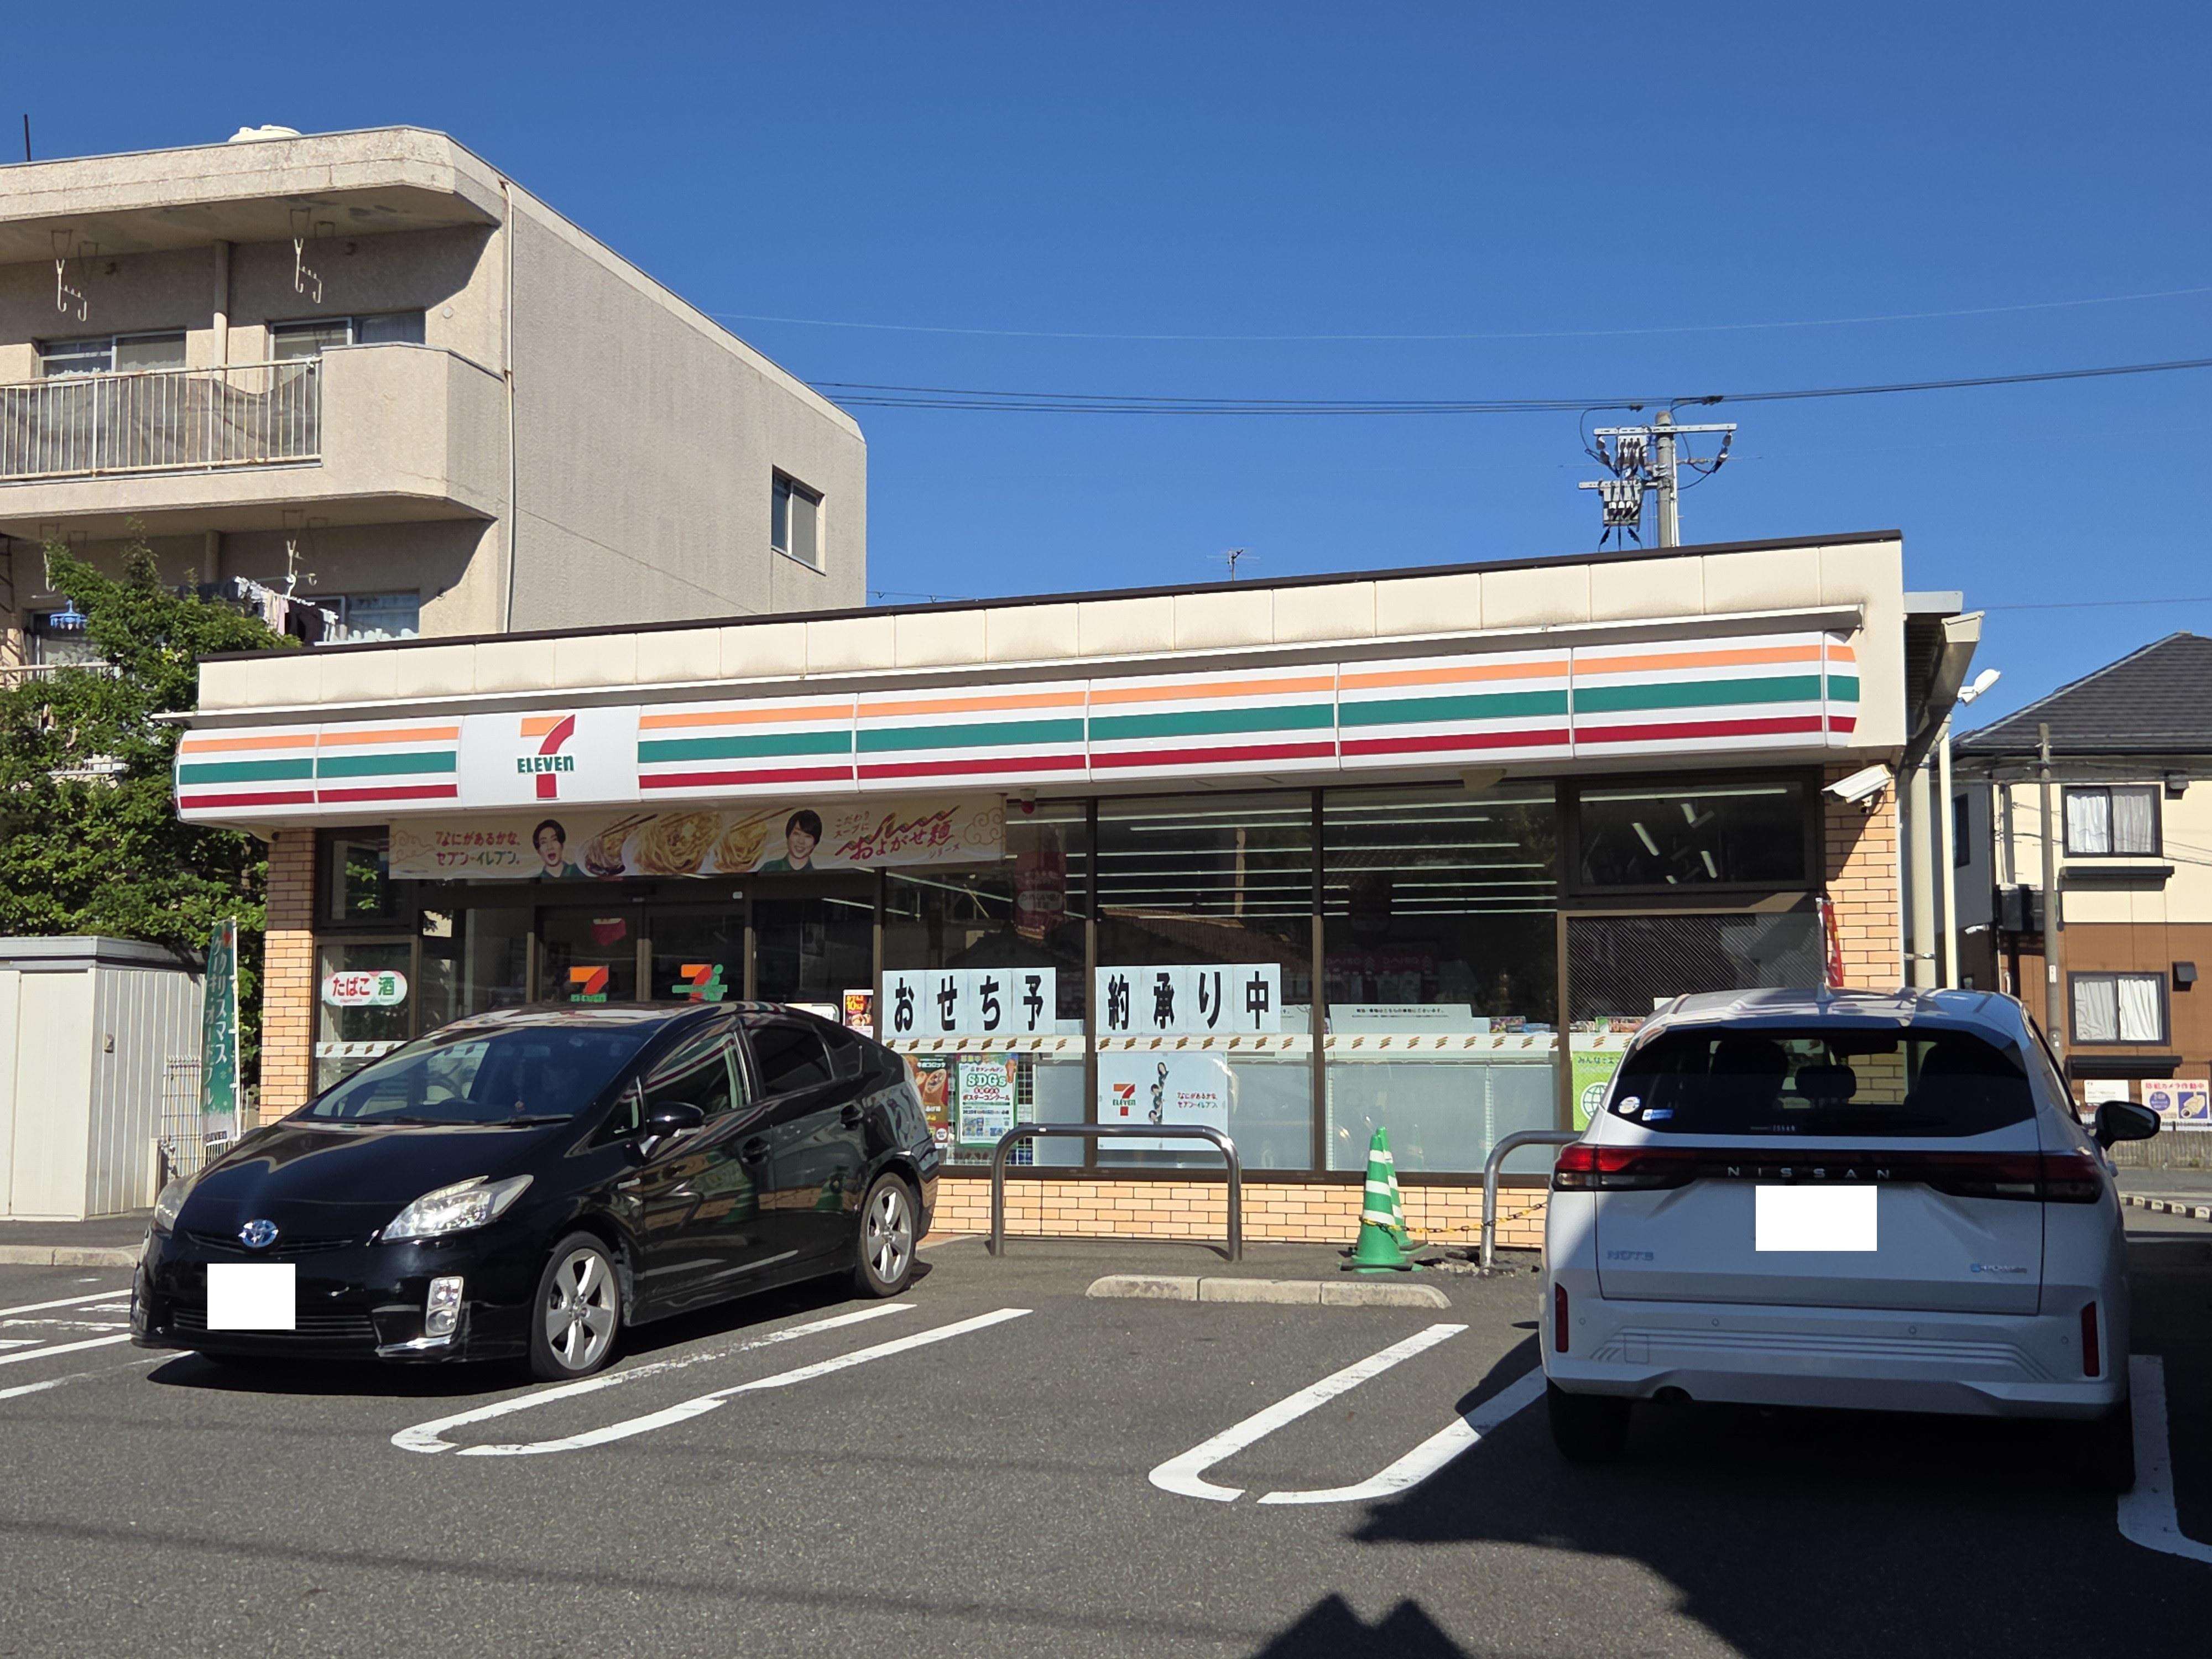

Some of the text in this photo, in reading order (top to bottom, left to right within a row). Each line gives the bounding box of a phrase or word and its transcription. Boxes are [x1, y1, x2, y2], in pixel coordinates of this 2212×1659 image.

[520, 714, 576, 798] 7
[333, 977, 395, 997] たばこ 酒
[894, 971, 1269, 1033] おせち予 約承り中
[967, 1073, 1008, 1087] SDGs
[1728, 1166, 1890, 1180] NISSAN
